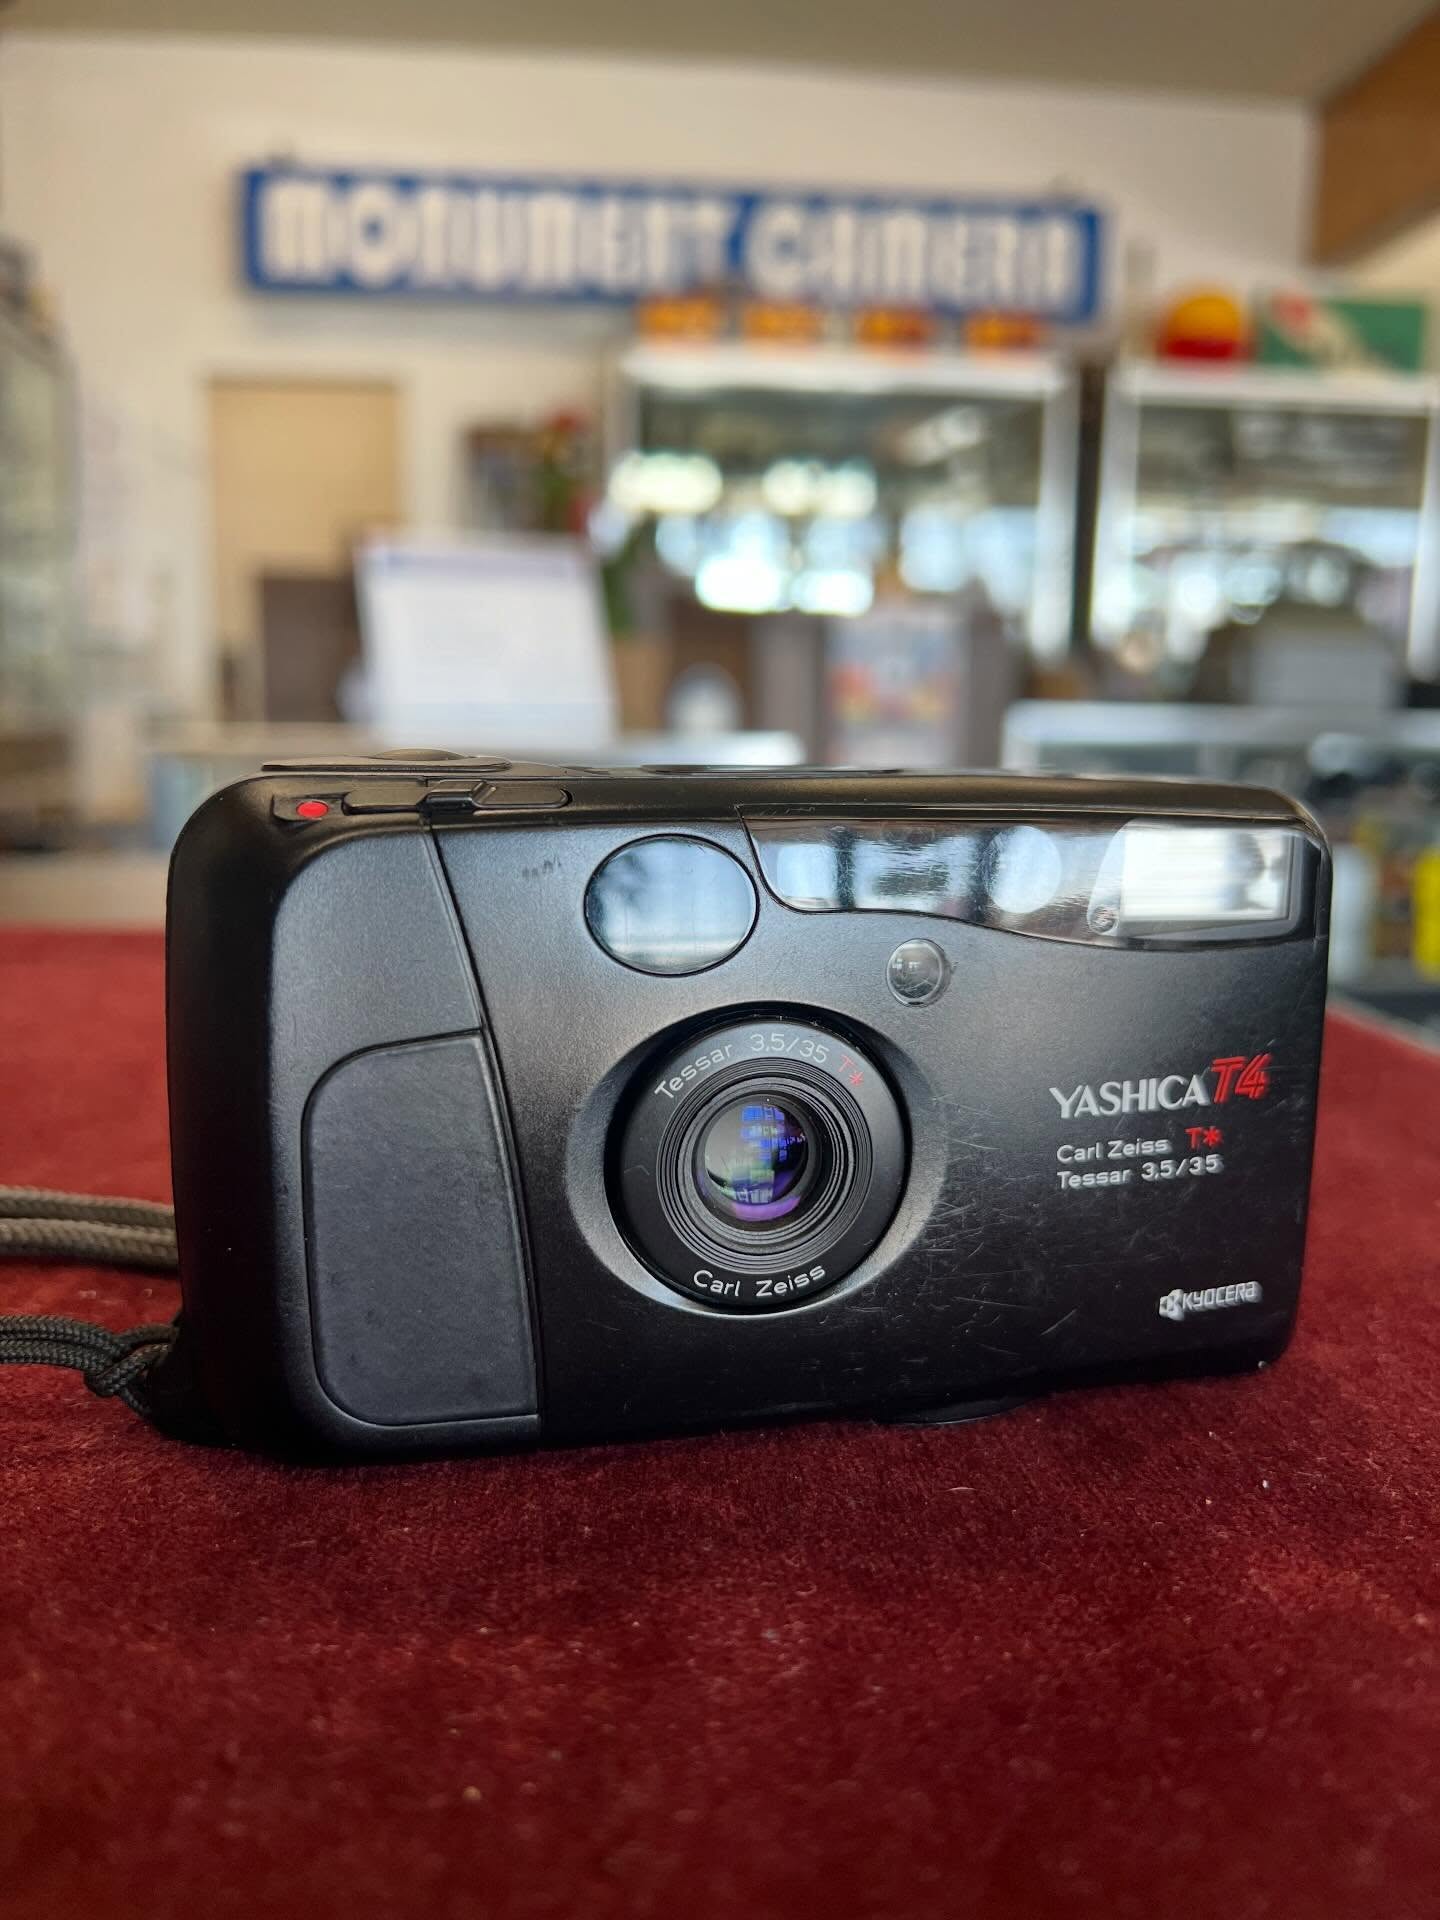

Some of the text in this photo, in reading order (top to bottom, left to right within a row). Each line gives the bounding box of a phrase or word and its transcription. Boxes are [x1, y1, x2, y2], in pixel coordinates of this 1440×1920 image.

[654, 1043, 734, 1100] Tessar
[1049, 1053, 1272, 1118] YASHICA T4
[1056, 1142, 1102, 1164] Carl
[1107, 1139, 1171, 1159] Zeiss
[1056, 1168, 1131, 1190] Tessar
[693, 1264, 826, 1298] Carl Zeiss
[1182, 1281, 1261, 1312] KYOCERA
